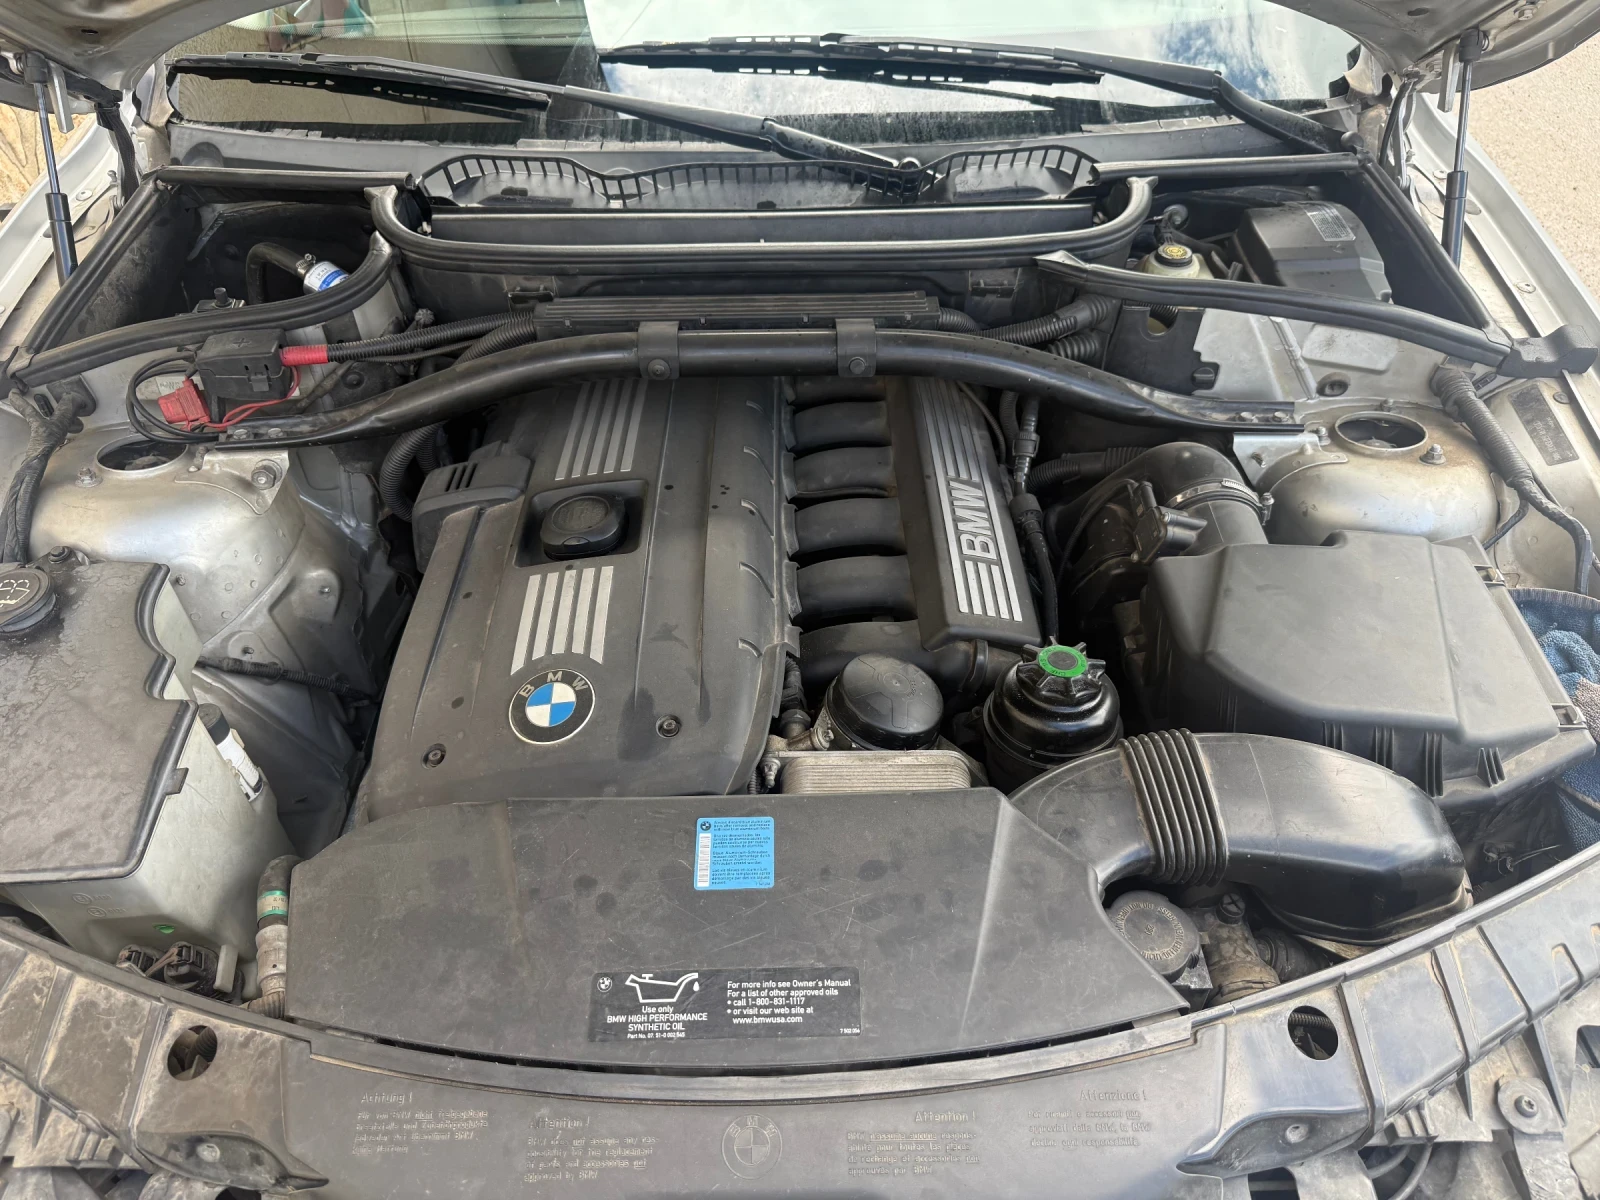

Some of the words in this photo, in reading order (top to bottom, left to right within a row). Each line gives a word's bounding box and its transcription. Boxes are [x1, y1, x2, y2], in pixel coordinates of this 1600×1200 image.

[948, 480, 997, 559] BMW
[519, 671, 588, 697] BMW
[727, 981, 740, 989] For
[762, 980, 777, 988] info
[792, 979, 822, 987] Owner's
[824, 979, 851, 987] Manual
[747, 989, 759, 997] list
[760, 989, 768, 997] of
[769, 989, 789, 997] other
[790, 988, 823, 997] approved
[825, 988, 839, 996] oils
[733, 998, 747, 1006] call
[748, 997, 806, 1006] 1-800-831-1117
[658, 1005, 674, 1013] only
[743, 1007, 758, 1015] visit
[774, 1006, 790, 1014] web
[791, 1006, 805, 1014] site
[806, 1006, 814, 1014] at
[607, 1015, 626, 1023] BMW
[628, 1014, 647, 1022] HIGH
[649, 1013, 708, 1022] PERFORMANCE
[732, 1016, 803, 1024] www.bmwusa.com
[628, 1023, 671, 1032] SYNTHETIC
[672, 1022, 685, 1030] OIL
[1080, 1090, 1140, 1101] Attenzione
[915, 1111, 969, 1122] Attention
